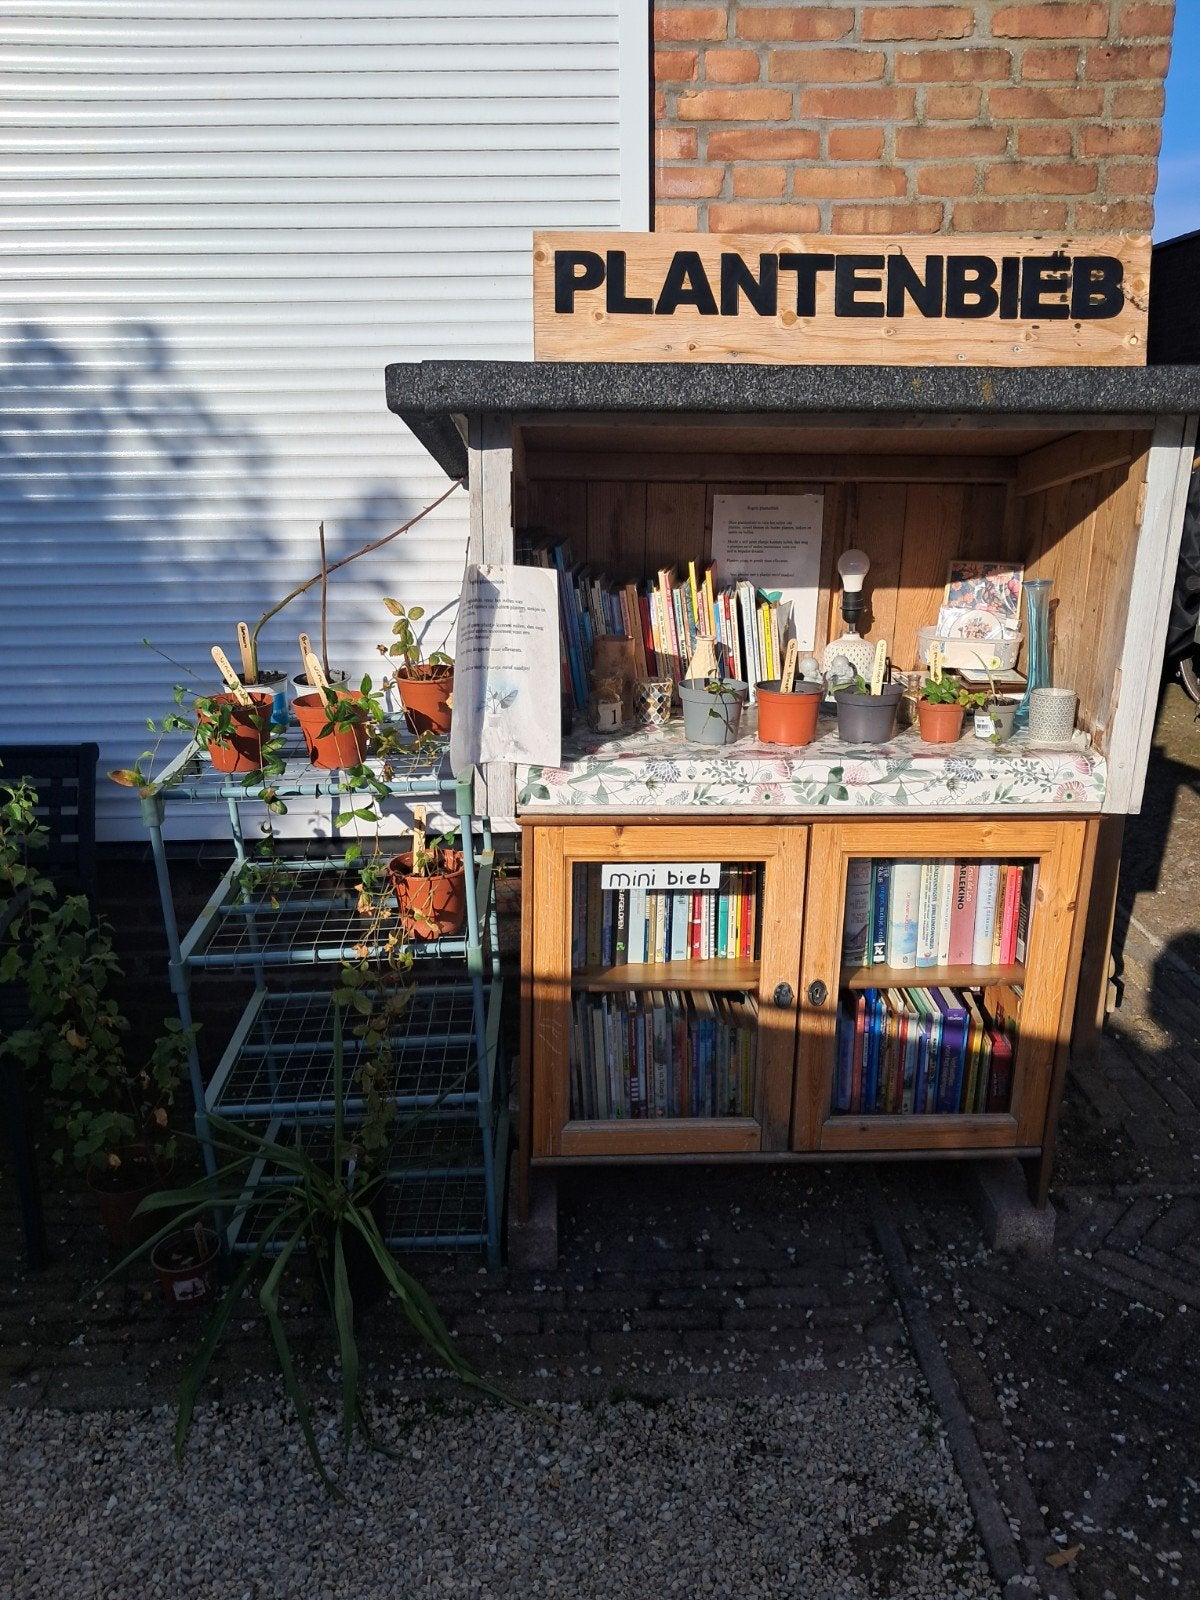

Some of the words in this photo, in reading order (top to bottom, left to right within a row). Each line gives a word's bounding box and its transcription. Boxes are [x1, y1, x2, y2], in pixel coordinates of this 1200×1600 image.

[553, 250, 1126, 320] PLANTENBIEB
[611, 709, 618, 725] 1
[609, 868, 656, 887] mini
[667, 867, 711, 886] bieb
